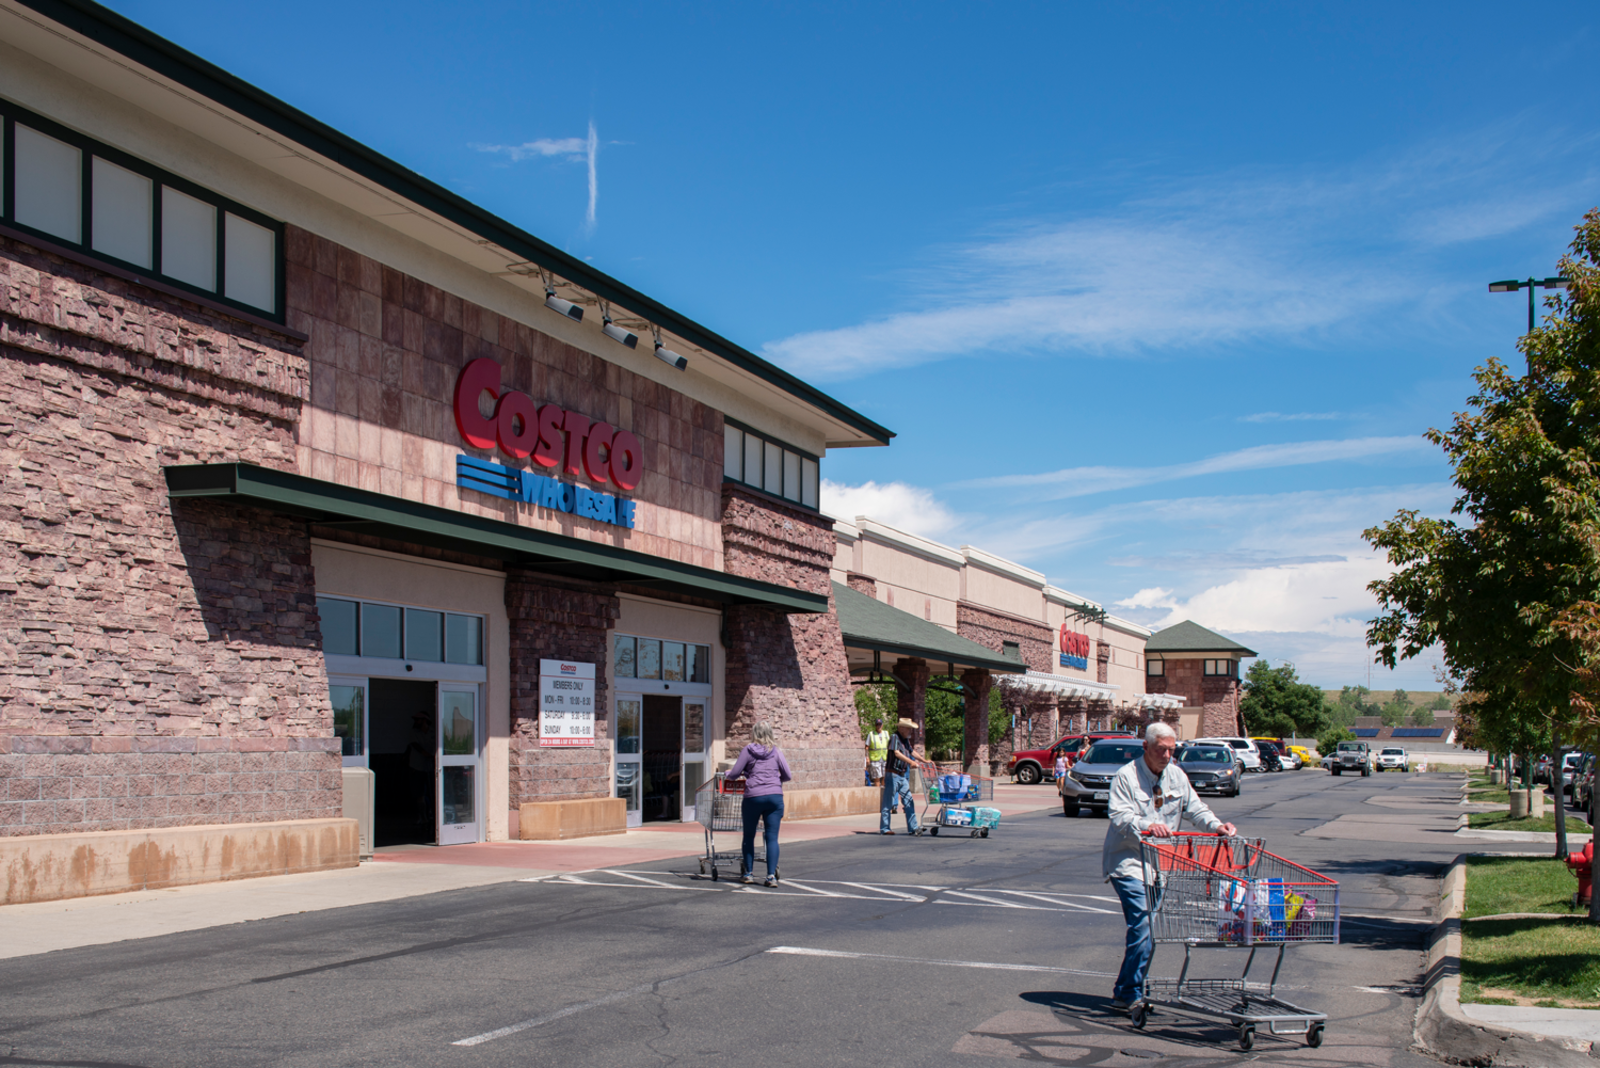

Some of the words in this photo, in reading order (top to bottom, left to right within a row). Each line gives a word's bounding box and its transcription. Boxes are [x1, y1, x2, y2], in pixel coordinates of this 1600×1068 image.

[453, 357, 643, 491] COSTCO
[520, 470, 637, 529] WHOLESALE
[1060, 623, 1090, 657] COSTCO
[553, 680, 572, 690] MEMBERS
[573, 682, 584, 690] ONLY
[544, 695, 554, 704] MON
[544, 710, 565, 719] SATURDAY
[544, 724, 561, 734] SUNDAY
